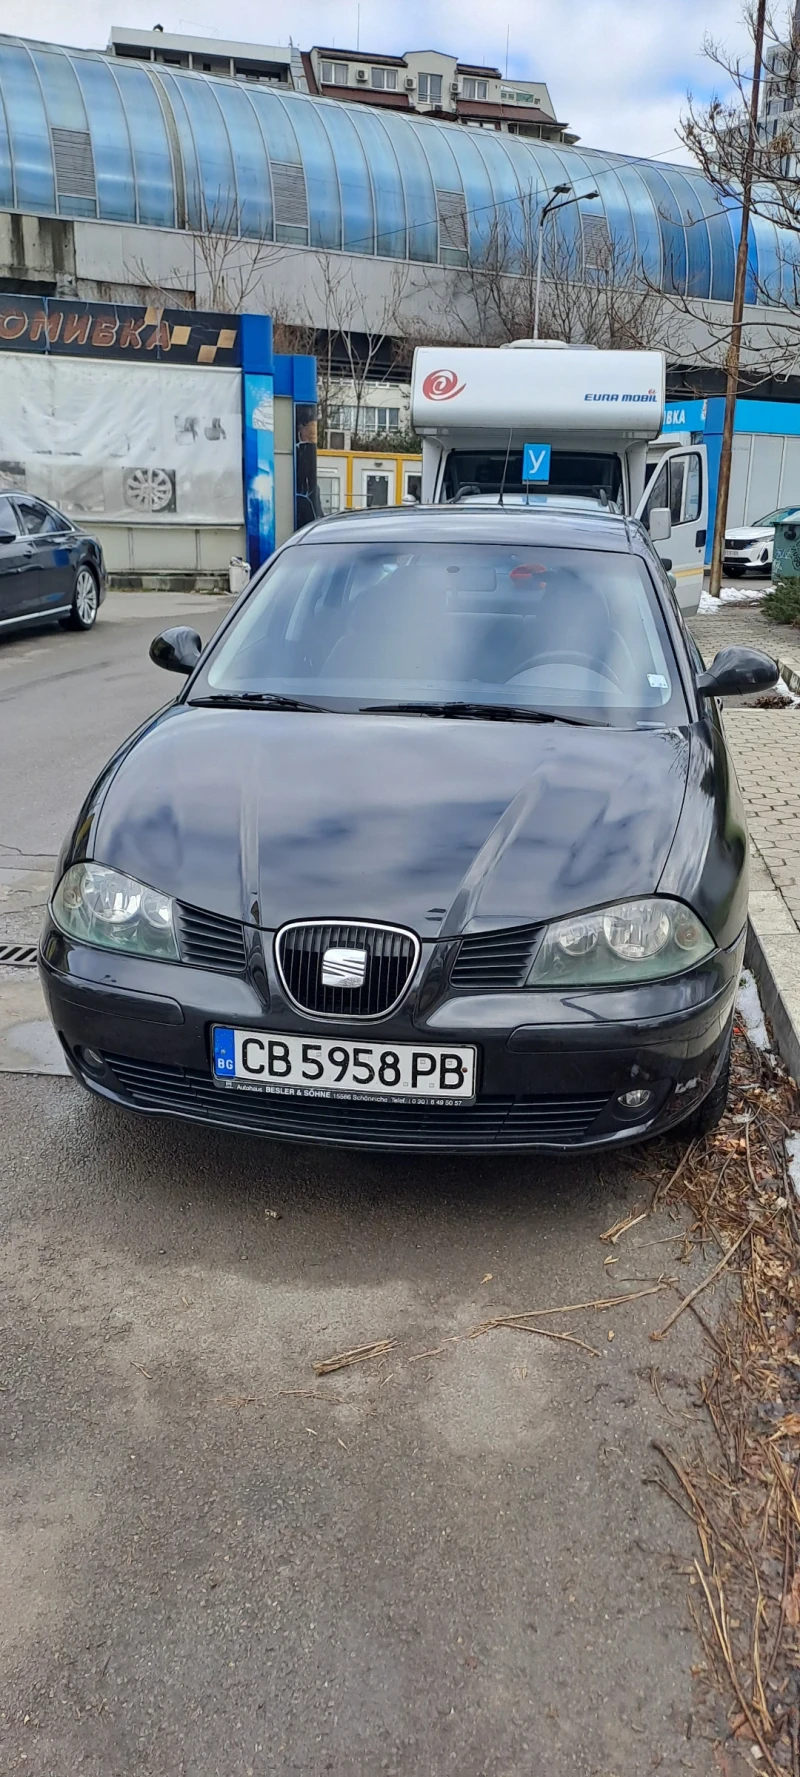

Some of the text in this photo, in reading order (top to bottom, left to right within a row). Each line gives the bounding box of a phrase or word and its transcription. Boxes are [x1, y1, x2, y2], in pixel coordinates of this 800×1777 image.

[584, 393, 657, 402] EURA MOBIL
[217, 1058, 234, 1071] BG
[241, 1038, 465, 1090] CB 5958 PB
[236, 1084, 263, 1093] Autohaus
[265, 1086, 295, 1096] BESLER
[303, 1089, 331, 1099] SÖHNE
